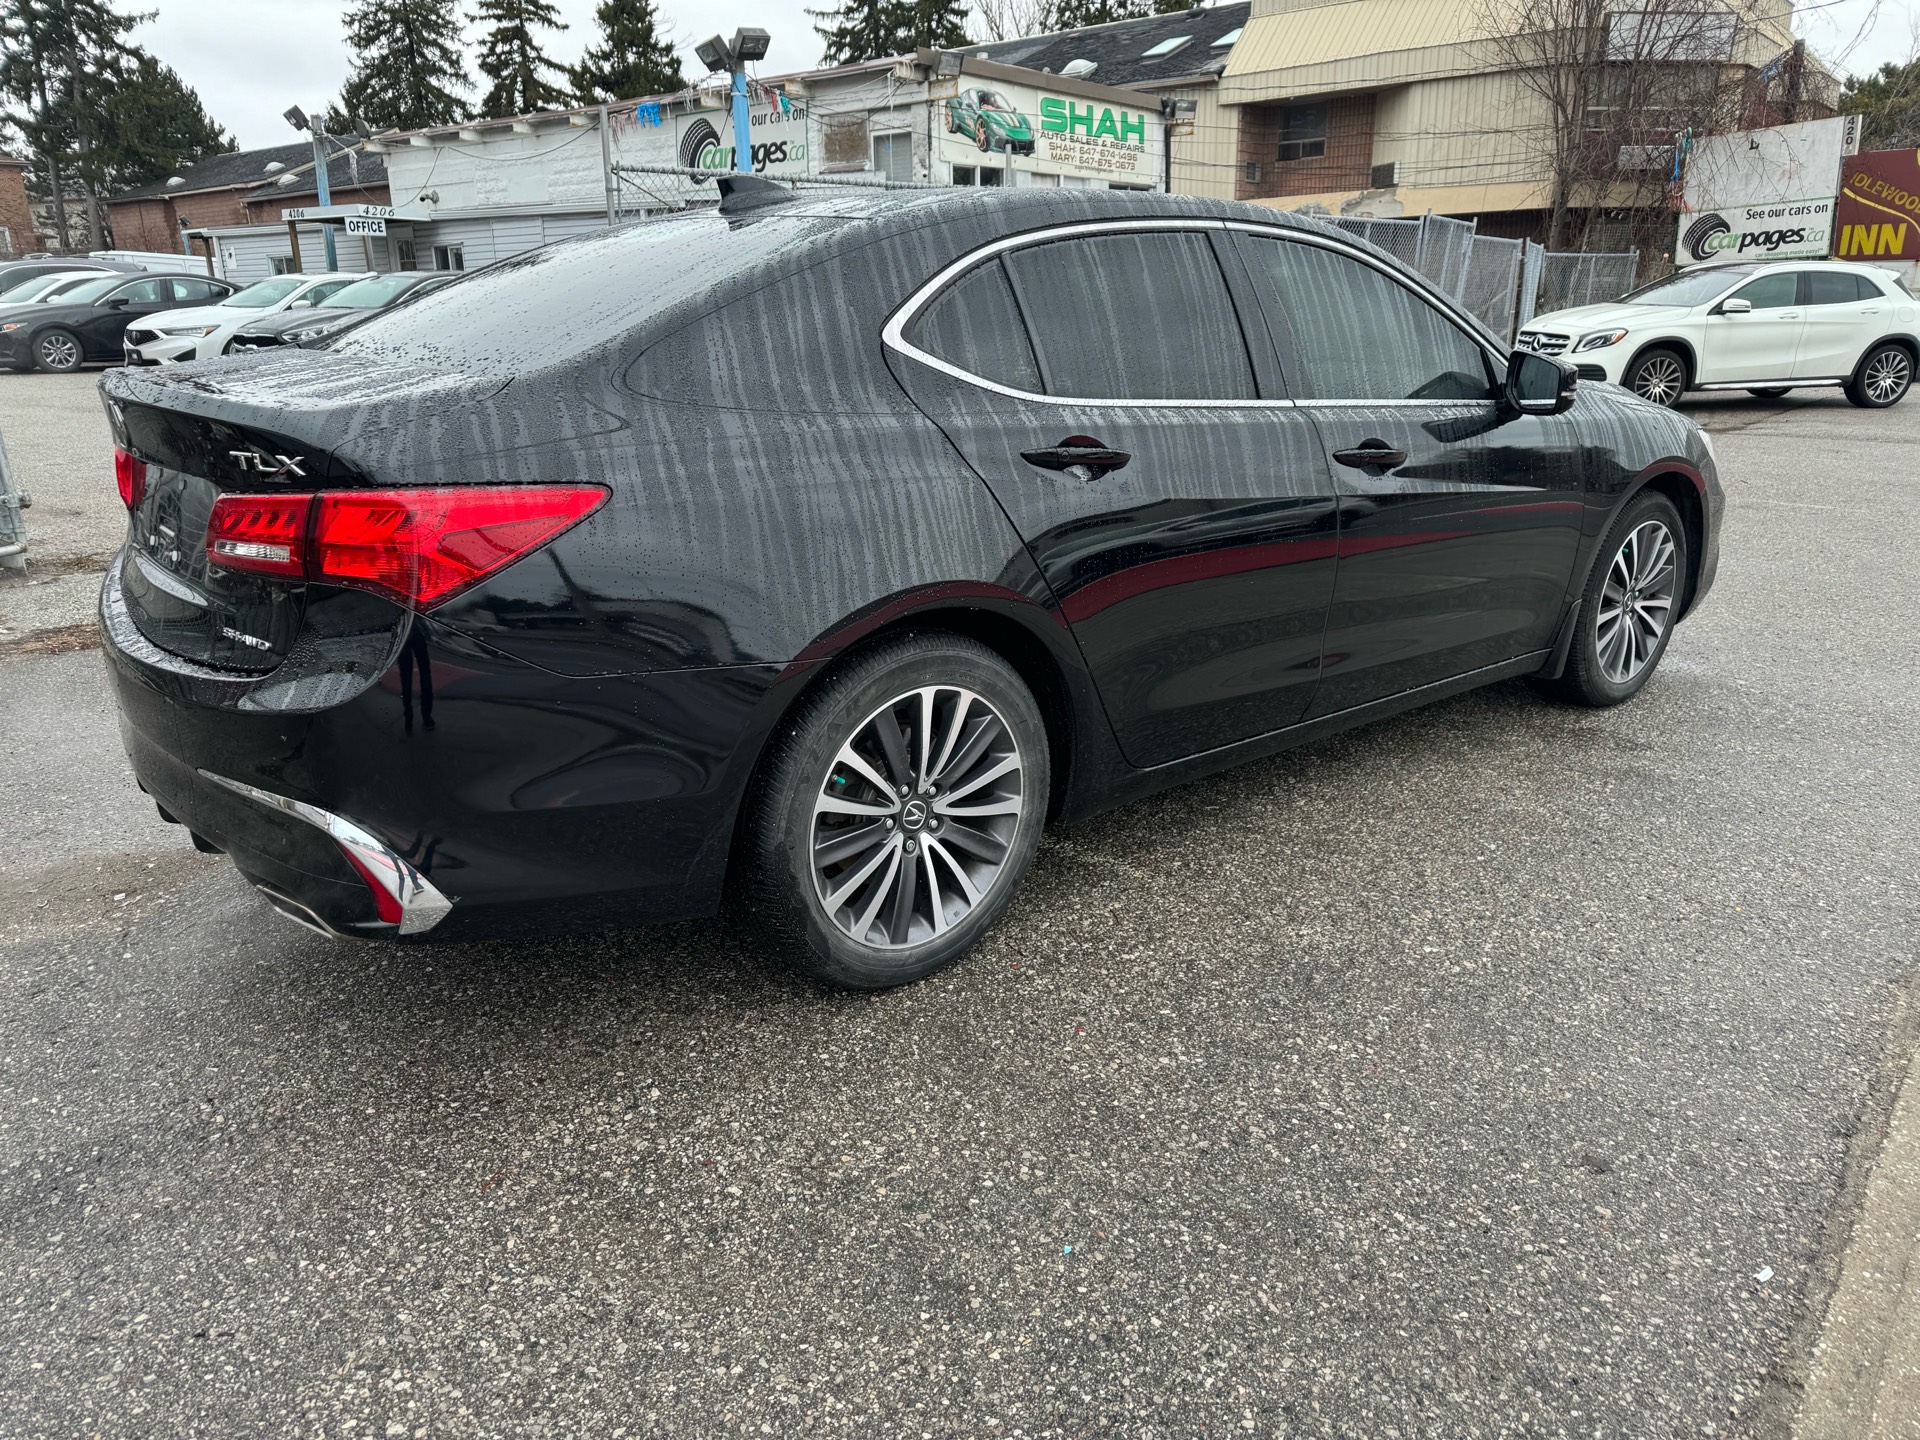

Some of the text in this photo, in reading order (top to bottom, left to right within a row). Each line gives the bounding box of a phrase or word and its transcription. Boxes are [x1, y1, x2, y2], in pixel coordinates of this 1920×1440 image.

[751, 112, 768, 126] our
[792, 108, 805, 121] on
[1040, 97, 1144, 144] SHAH
[1040, 131, 1146, 154] AUTO SALES & REPAIRS
[1048, 141, 1138, 162] SHAH: 647-674-1496
[1050, 151, 1078, 163] MARY:
[288, 208, 305, 219] 4206
[362, 205, 396, 217] 4206
[1745, 203, 1829, 220] See our cars on
[348, 220, 384, 233] OFFICE
[1707, 227, 1826, 254] carpages.ca
[1838, 222, 1908, 256] INN
[228, 450, 307, 477] TLX
